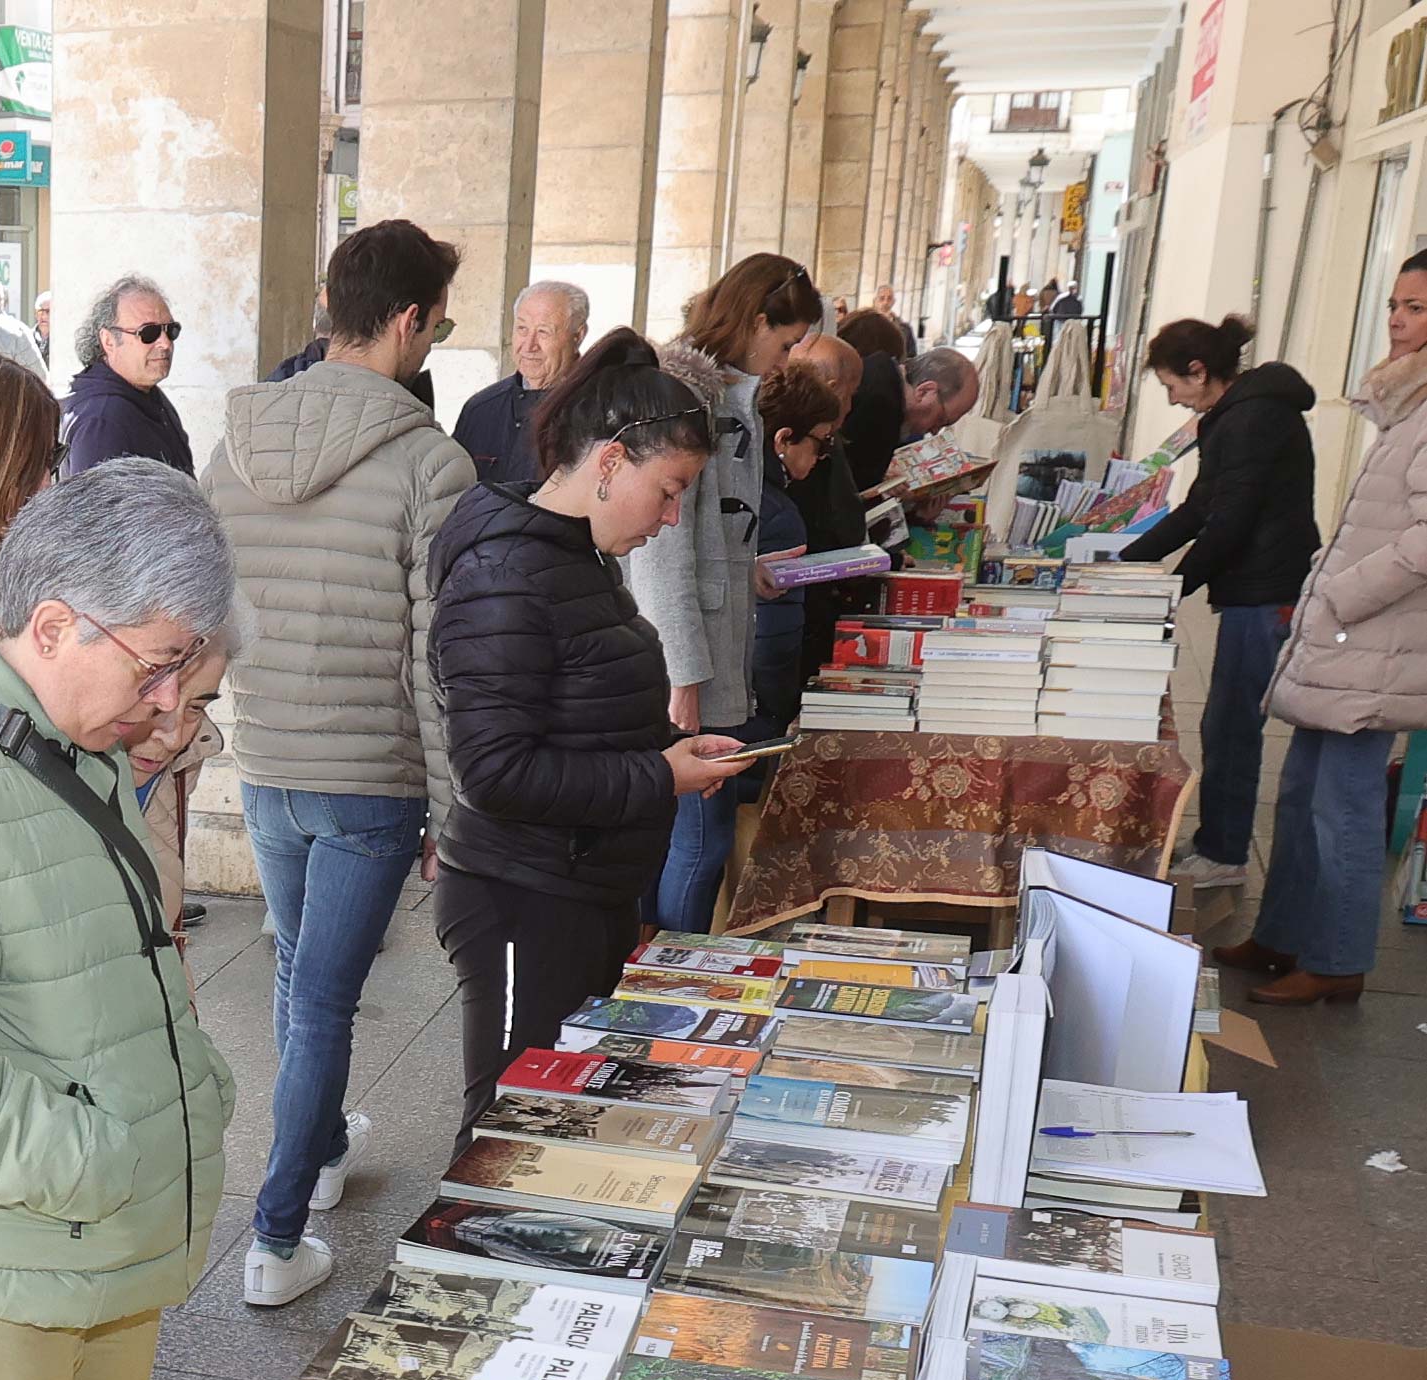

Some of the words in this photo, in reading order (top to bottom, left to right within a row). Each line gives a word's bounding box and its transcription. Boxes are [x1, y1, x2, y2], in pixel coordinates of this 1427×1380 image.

[14, 28, 43, 47] VENTA
[825, 1090, 853, 1122] COMBATE
[619, 1231, 643, 1243] EL
[604, 1241, 637, 1269] CANAL
[810, 1333, 835, 1369] PALENTINA
